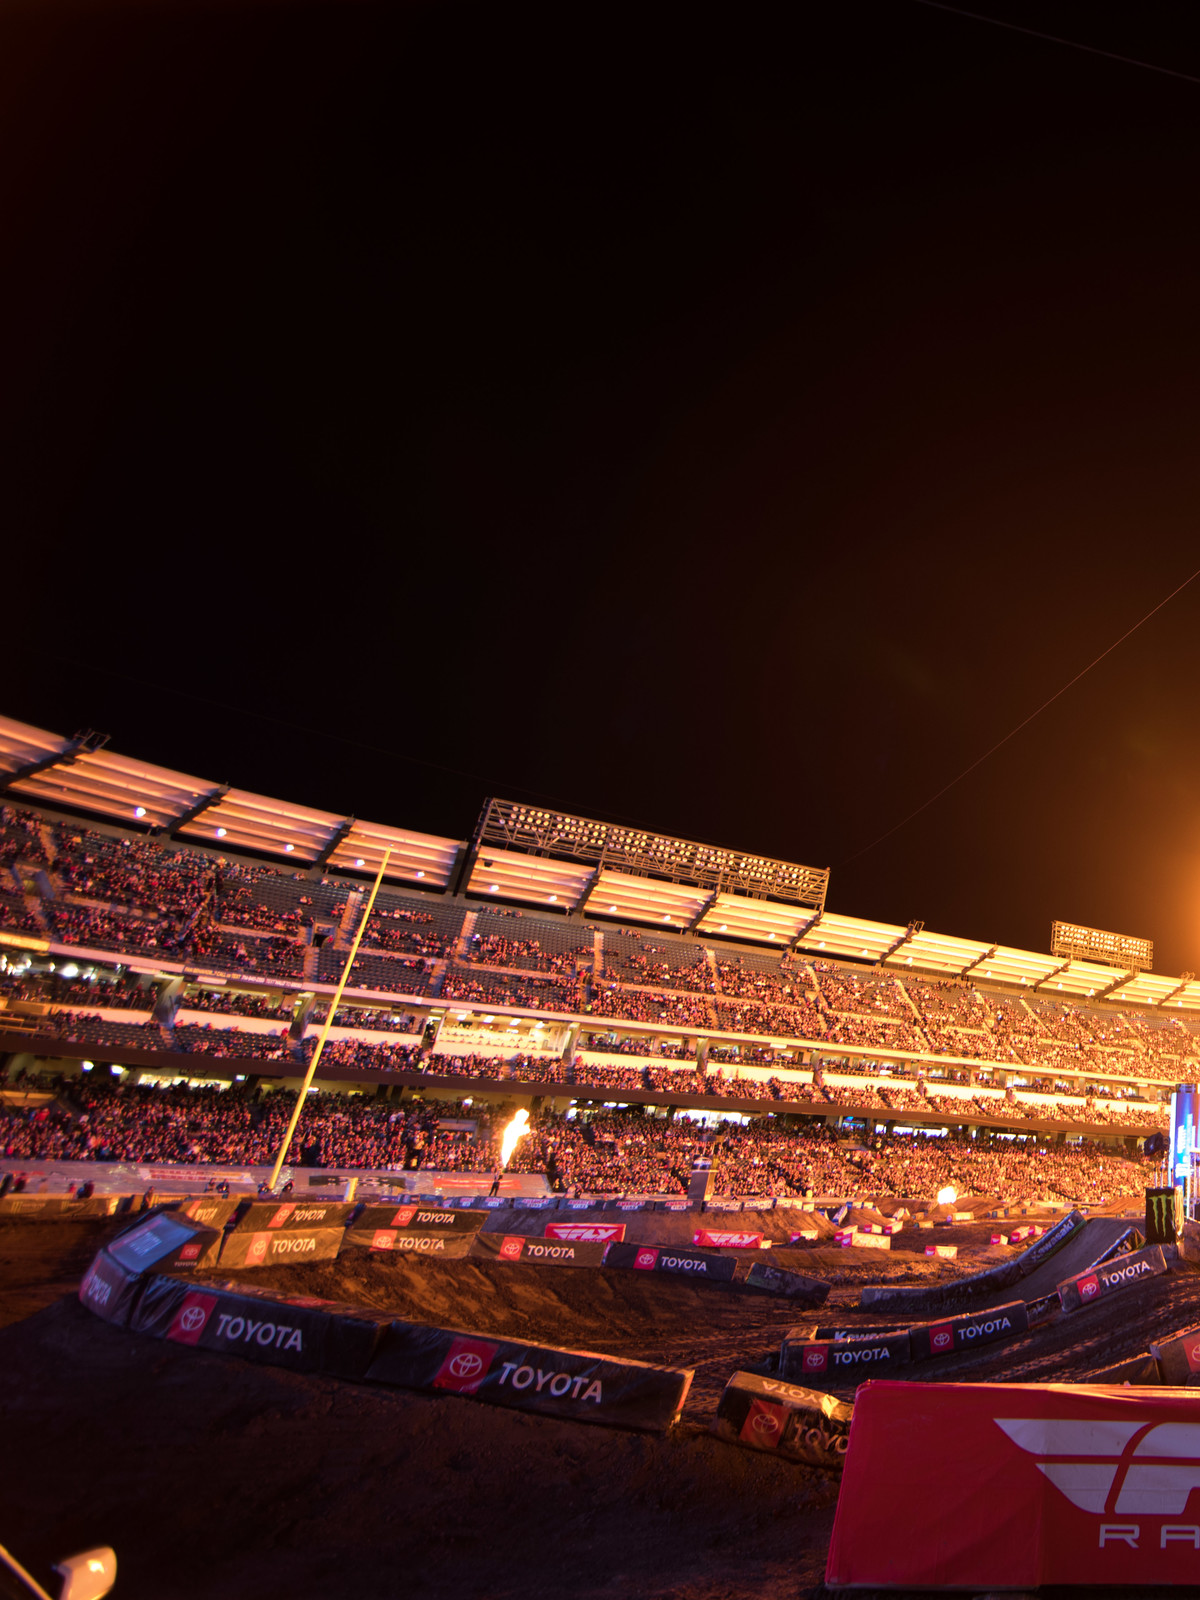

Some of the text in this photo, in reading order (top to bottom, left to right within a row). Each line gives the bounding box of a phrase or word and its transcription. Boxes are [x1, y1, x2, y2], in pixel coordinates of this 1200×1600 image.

[291, 1209, 327, 1221] TOYOTA
[416, 1211, 456, 1224] TOYOTA
[271, 1238, 316, 1254] TOYOTA
[398, 1237, 445, 1250] TOYOTA
[706, 1232, 760, 1245] FLY
[1030, 1218, 1076, 1261] Kawasaki
[527, 1244, 575, 1259] TOYOTA
[661, 1256, 707, 1272] TOYOTA
[1102, 1260, 1150, 1287] TOYOTA
[216, 1313, 304, 1353] TOYOTA
[958, 1317, 1011, 1340] TOYOTA
[834, 1347, 890, 1365] TOYOTA
[499, 1361, 602, 1403] TOYOTA
